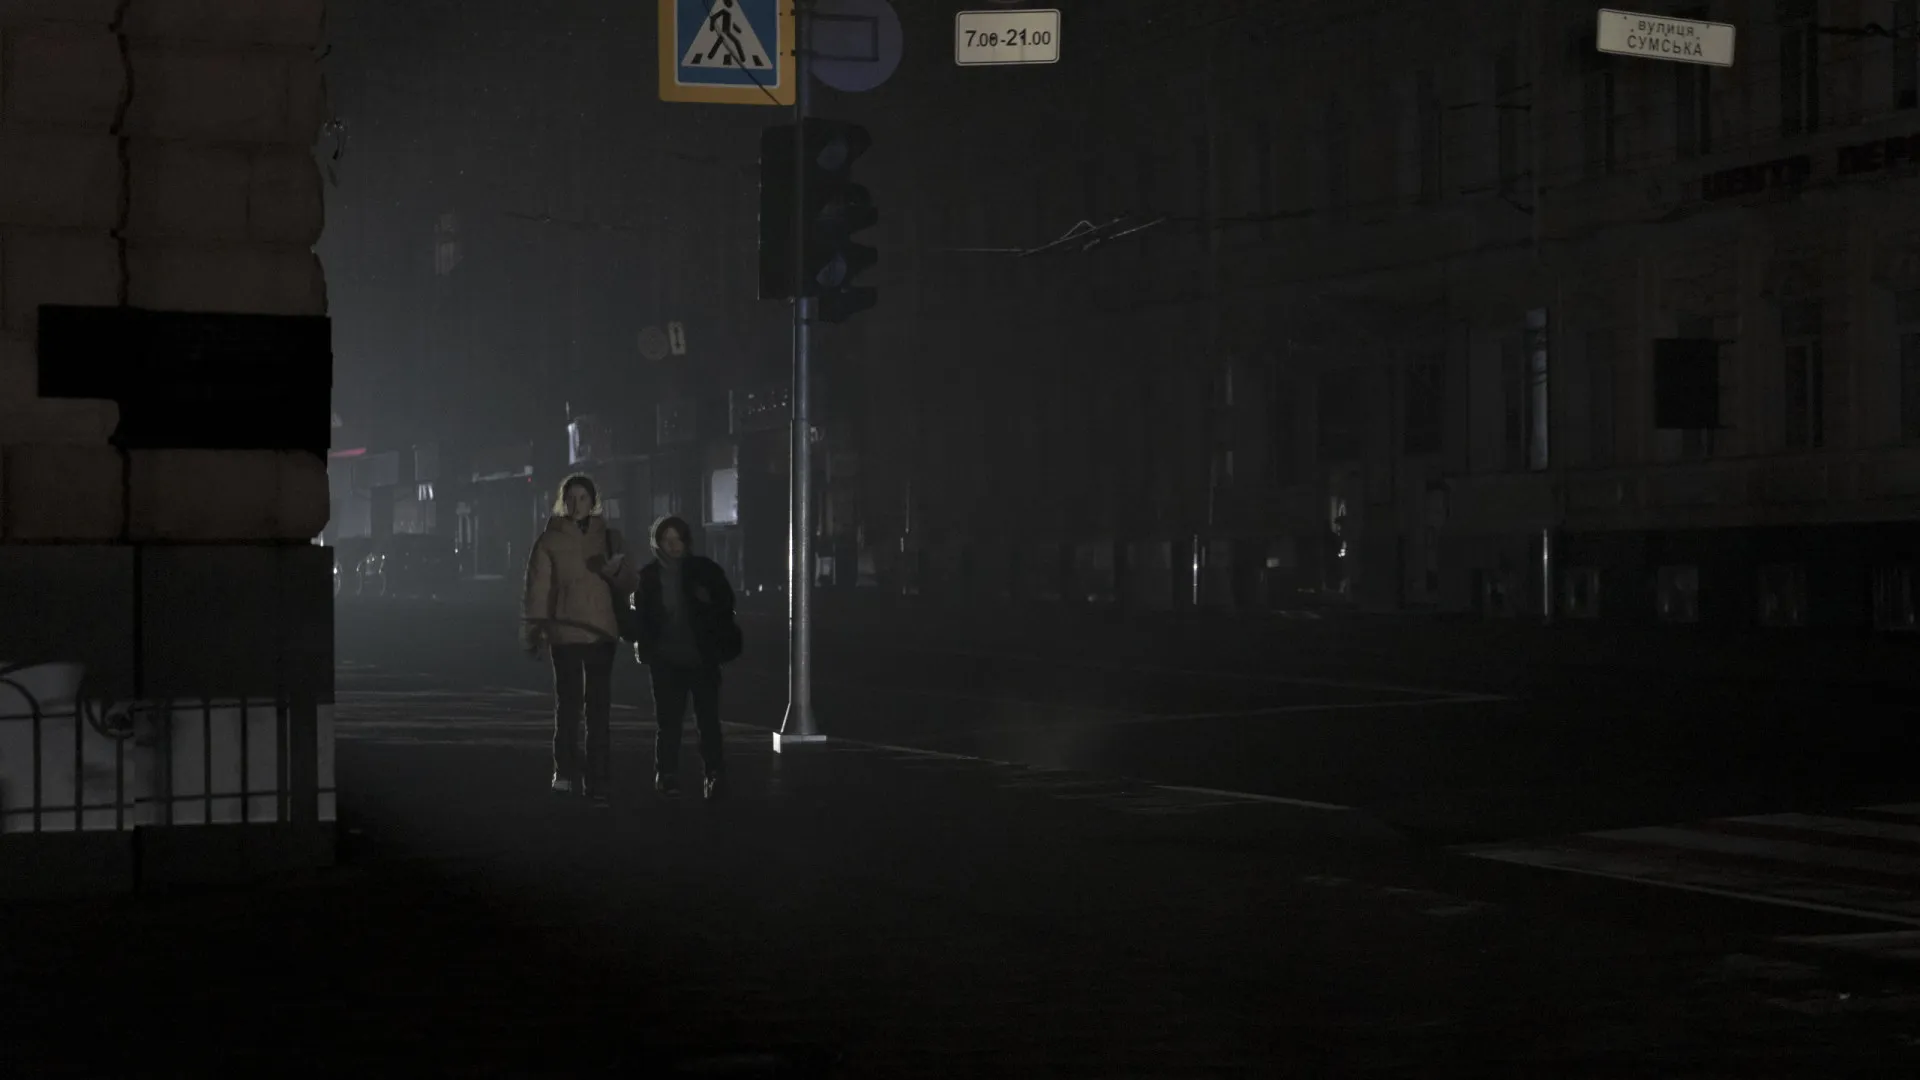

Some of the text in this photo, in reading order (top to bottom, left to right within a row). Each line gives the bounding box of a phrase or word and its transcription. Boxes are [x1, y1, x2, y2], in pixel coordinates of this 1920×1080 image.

[964, 28, 1051, 48] 7.00-21.00
[1638, 20, 1695, 37] вулиця
[1627, 34, 1704, 57] СУМСЬКА
